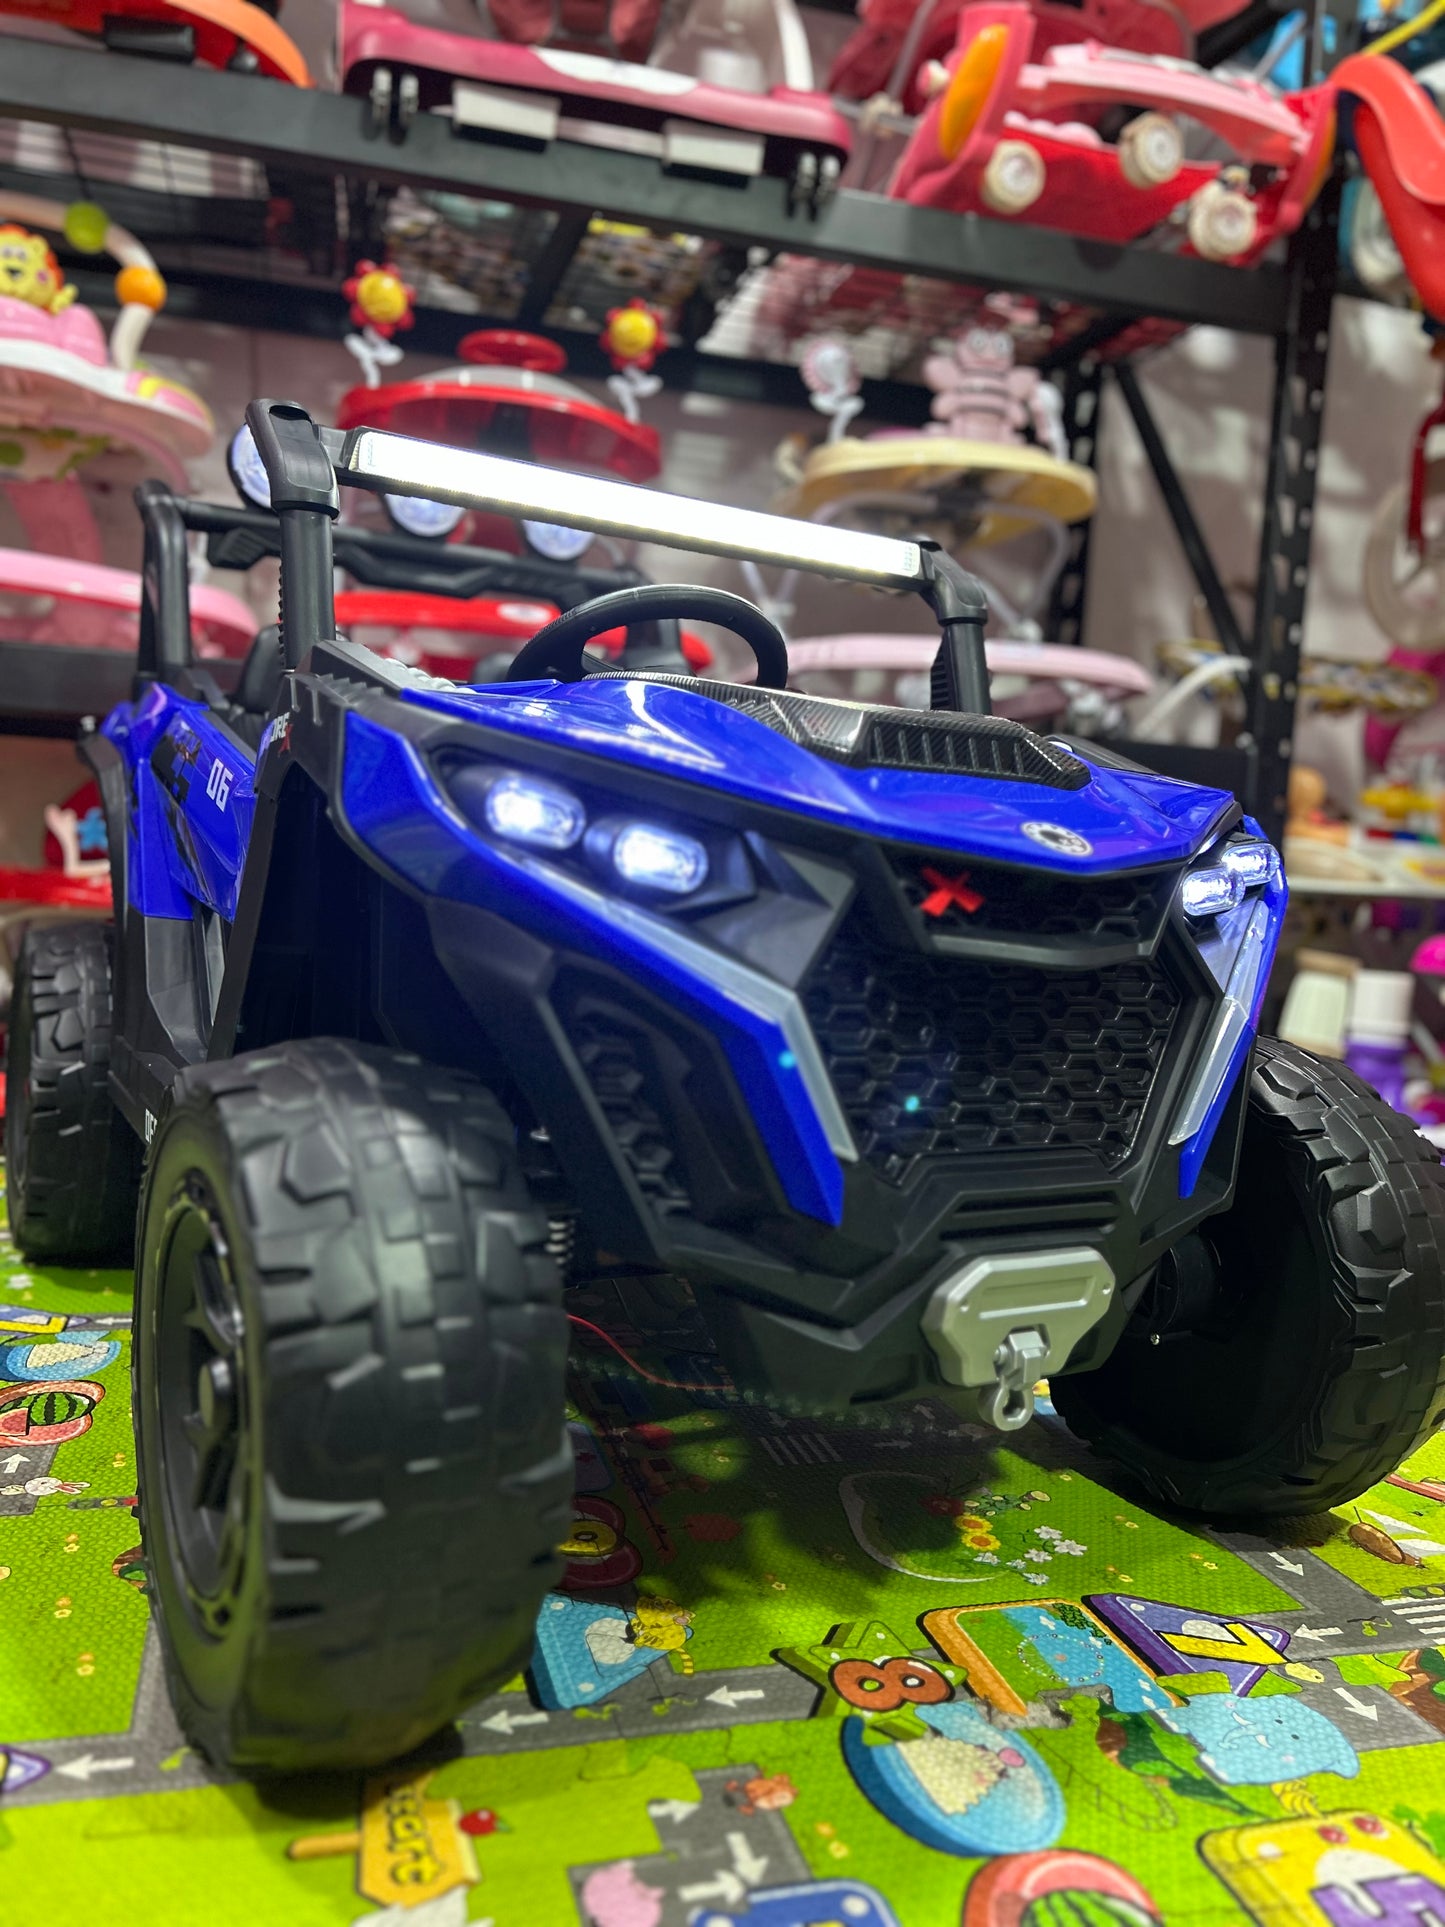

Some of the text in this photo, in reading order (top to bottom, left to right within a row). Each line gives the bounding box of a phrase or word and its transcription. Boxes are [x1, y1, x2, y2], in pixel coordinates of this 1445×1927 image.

[206, 758, 234, 813] 06
[1153, 1621, 1292, 1666] 7
[828, 1658, 956, 1712] 8
